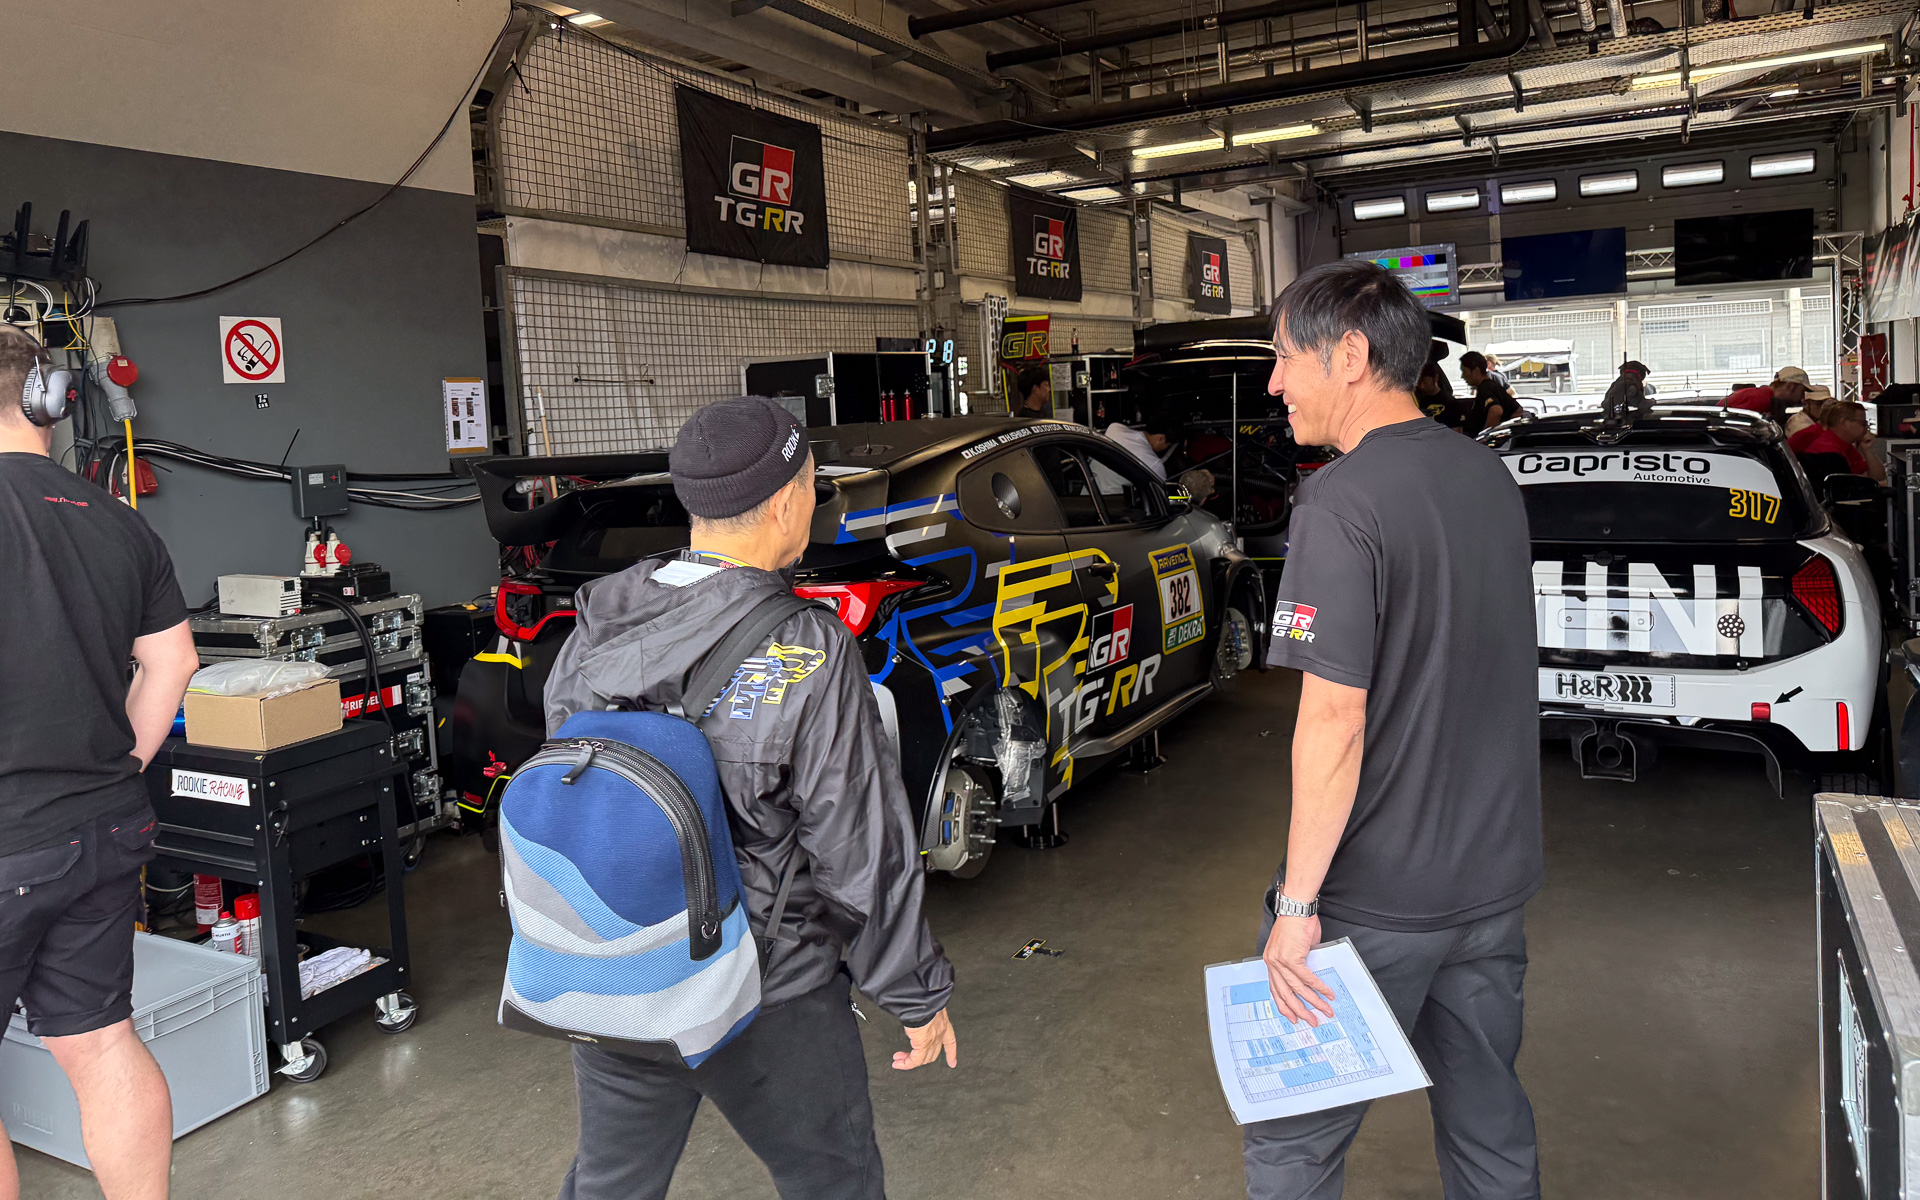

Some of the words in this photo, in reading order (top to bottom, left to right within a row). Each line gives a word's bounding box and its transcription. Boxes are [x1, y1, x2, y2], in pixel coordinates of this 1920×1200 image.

[732, 162, 790, 201] GR
[714, 195, 804, 234] TG-RR
[1035, 232, 1063, 257] GR
[1026, 257, 1070, 279] TG-RR
[1203, 264, 1219, 282] GR
[1002, 331, 1049, 359] GR
[1518, 451, 1711, 476] Capristo
[1633, 472, 1711, 485] Automotive
[1729, 488, 1780, 524] 317
[1158, 552, 1188, 570] RAVENOL
[1170, 575, 1191, 619] 382
[1177, 620, 1203, 644] DEKRA
[1273, 610, 1312, 629] GR
[1272, 625, 1316, 643] G-RR
[1089, 627, 1130, 669] GR
[1556, 672, 1618, 699] H&R
[1058, 653, 1162, 747] TG-RR
[177, 775, 208, 795] ROOKIE
[209, 780, 245, 800] RACING
